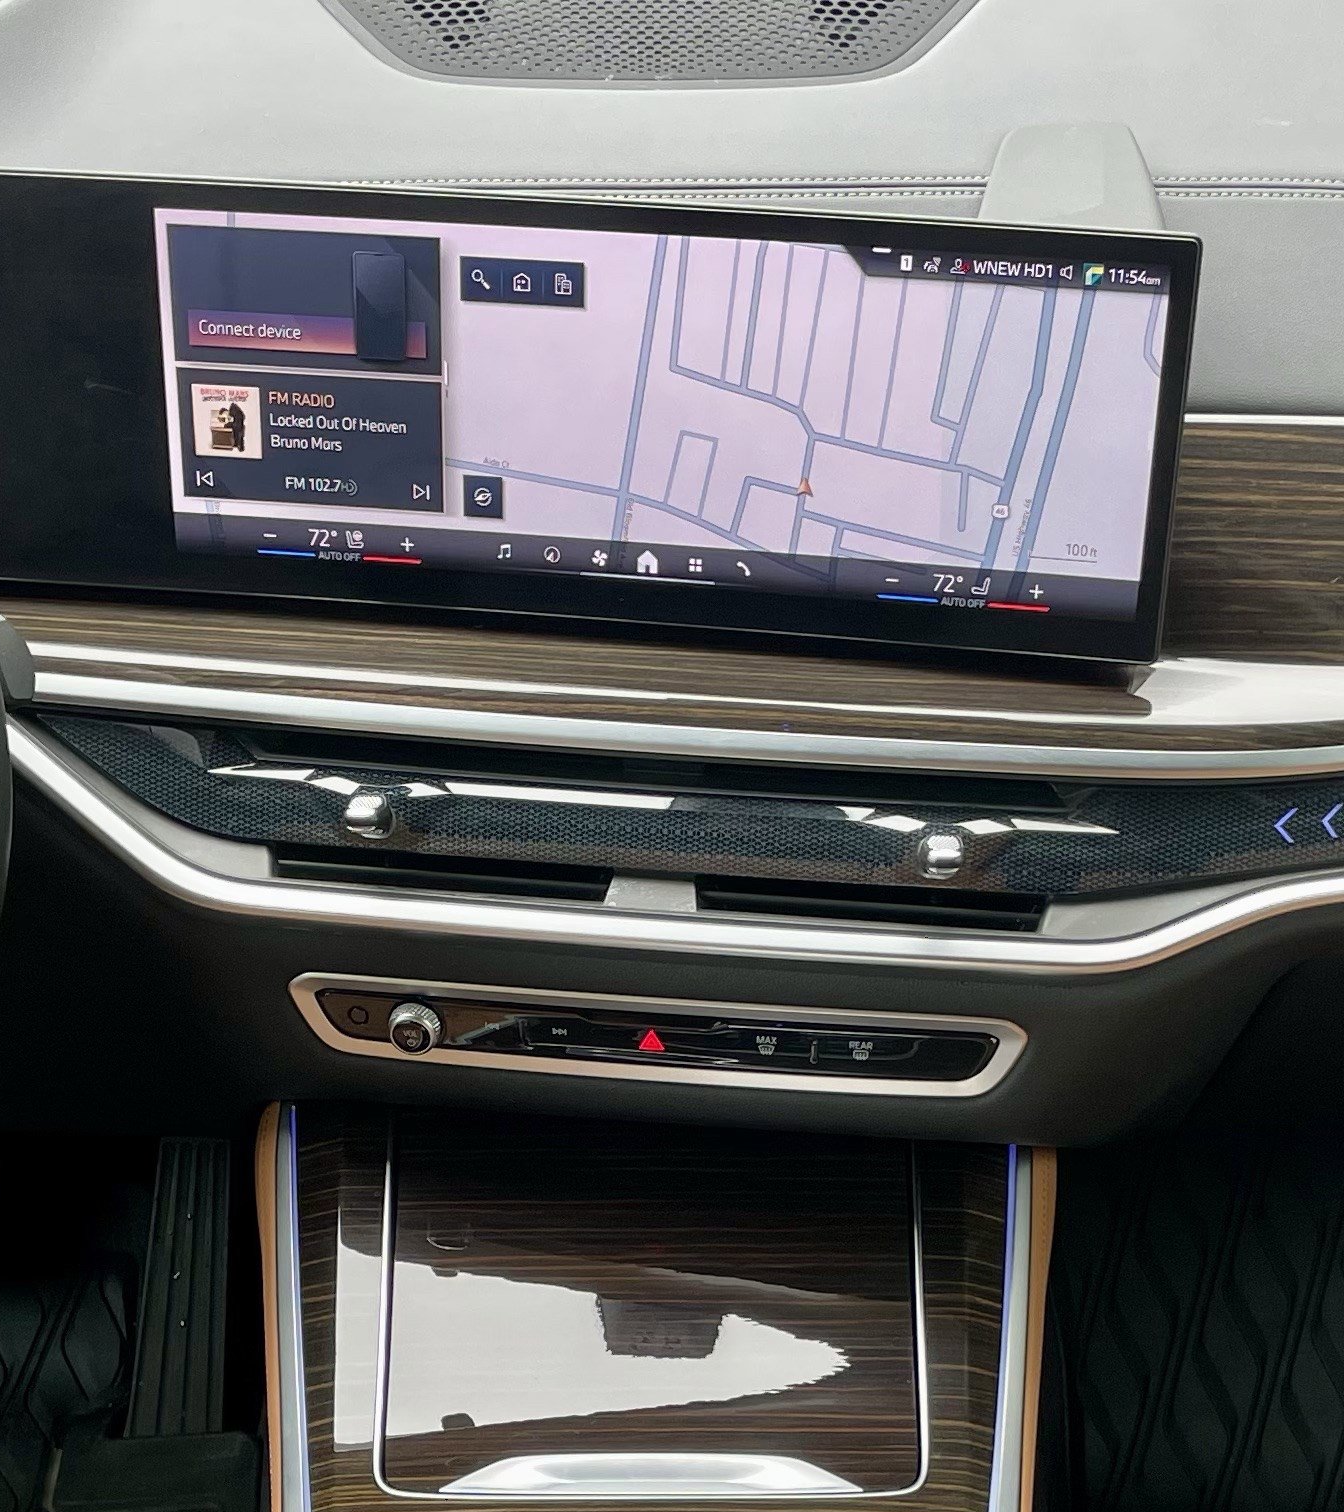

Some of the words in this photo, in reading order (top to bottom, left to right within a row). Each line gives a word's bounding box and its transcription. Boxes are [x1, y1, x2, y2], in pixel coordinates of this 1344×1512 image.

[973, 260, 1022, 277] WNEW
[1024, 262, 1054, 278] HD1
[199, 319, 254, 337] Connect
[258, 321, 302, 340] device
[269, 391, 289, 405] FM
[292, 393, 334, 409] RADIO
[269, 413, 314, 429] Locked
[316, 415, 339, 430] Out
[342, 416, 358, 431] Of
[359, 418, 407, 434] Heaven
[270, 435, 309, 449] Bruno
[311, 437, 343, 452] Mars
[285, 477, 305, 490] FM
[308, 528, 338, 548] 72°
[318, 551, 342, 561] AUTO
[344, 552, 361, 563] OFF
[1066, 543, 1088, 557] 100
[932, 573, 964, 593] 72°
[940, 597, 966, 607] AUTO
[967, 598, 986, 609] OFF
[756, 1035, 777, 1045] MAX
[848, 1041, 874, 1050] REAR
